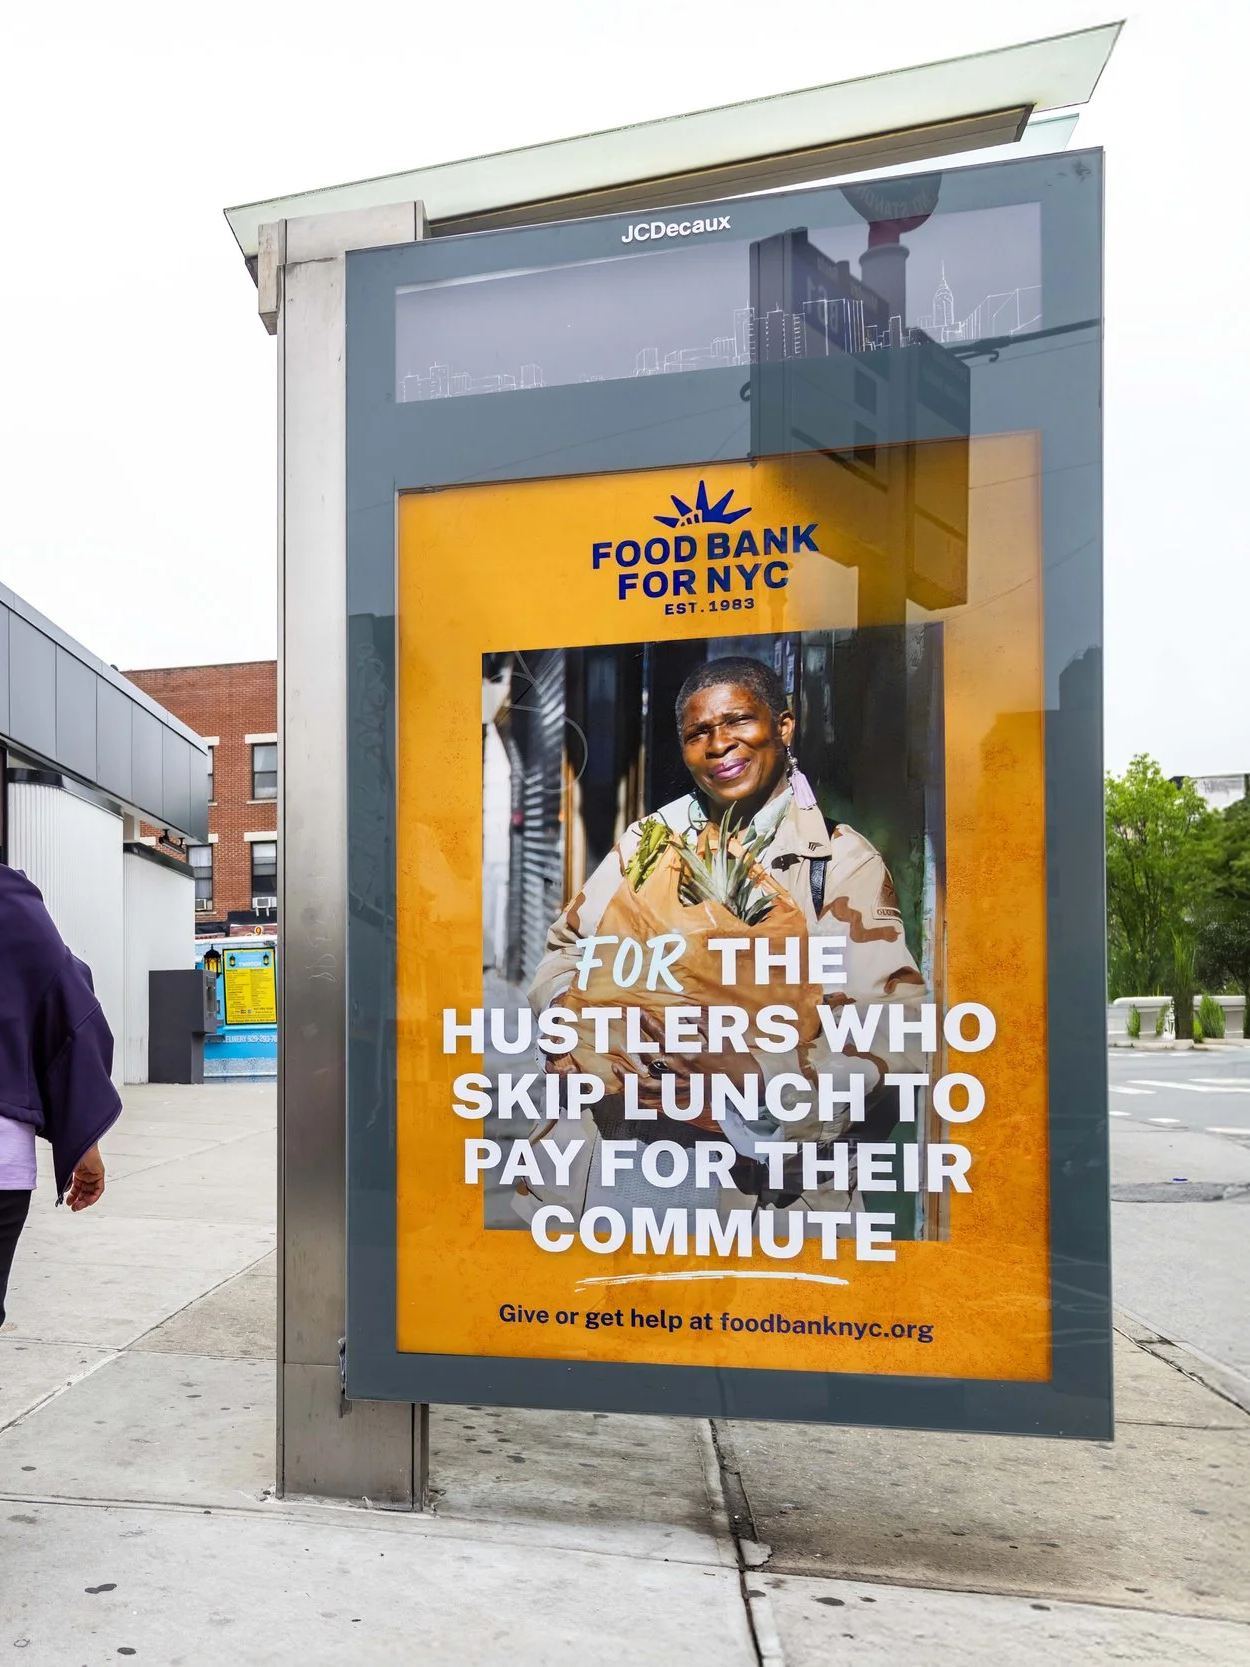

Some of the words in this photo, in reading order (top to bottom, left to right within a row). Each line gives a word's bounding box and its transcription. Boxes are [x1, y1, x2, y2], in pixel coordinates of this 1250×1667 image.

[621, 215, 731, 243] JCDecaux
[592, 535, 697, 570] FOOD
[707, 523, 820, 560] BANK
[618, 569, 697, 600] FOR
[707, 561, 789, 594] NYC
[575, 934, 687, 992] FOR
[707, 935, 847, 986] THE
[442, 1004, 799, 1055] HUSTLERS
[817, 1002, 997, 1053] WHO
[452, 1072, 605, 1120] SKIP
[625, 1072, 866, 1122] LUNCH
[884, 1073, 986, 1122] TO
[464, 1138, 585, 1187] PAY
[601, 1140, 738, 1189] FOR
[754, 1142, 973, 1193] THEIR
[530, 1206, 897, 1262] COMMUTE
[499, 1303, 549, 1324] Give
[555, 1310, 579, 1325] or
[585, 1309, 624, 1330] get
[631, 1308, 683, 1332] help
[689, 1312, 713, 1330] at
[720, 1312, 934, 1344] foodbanknyc.org
